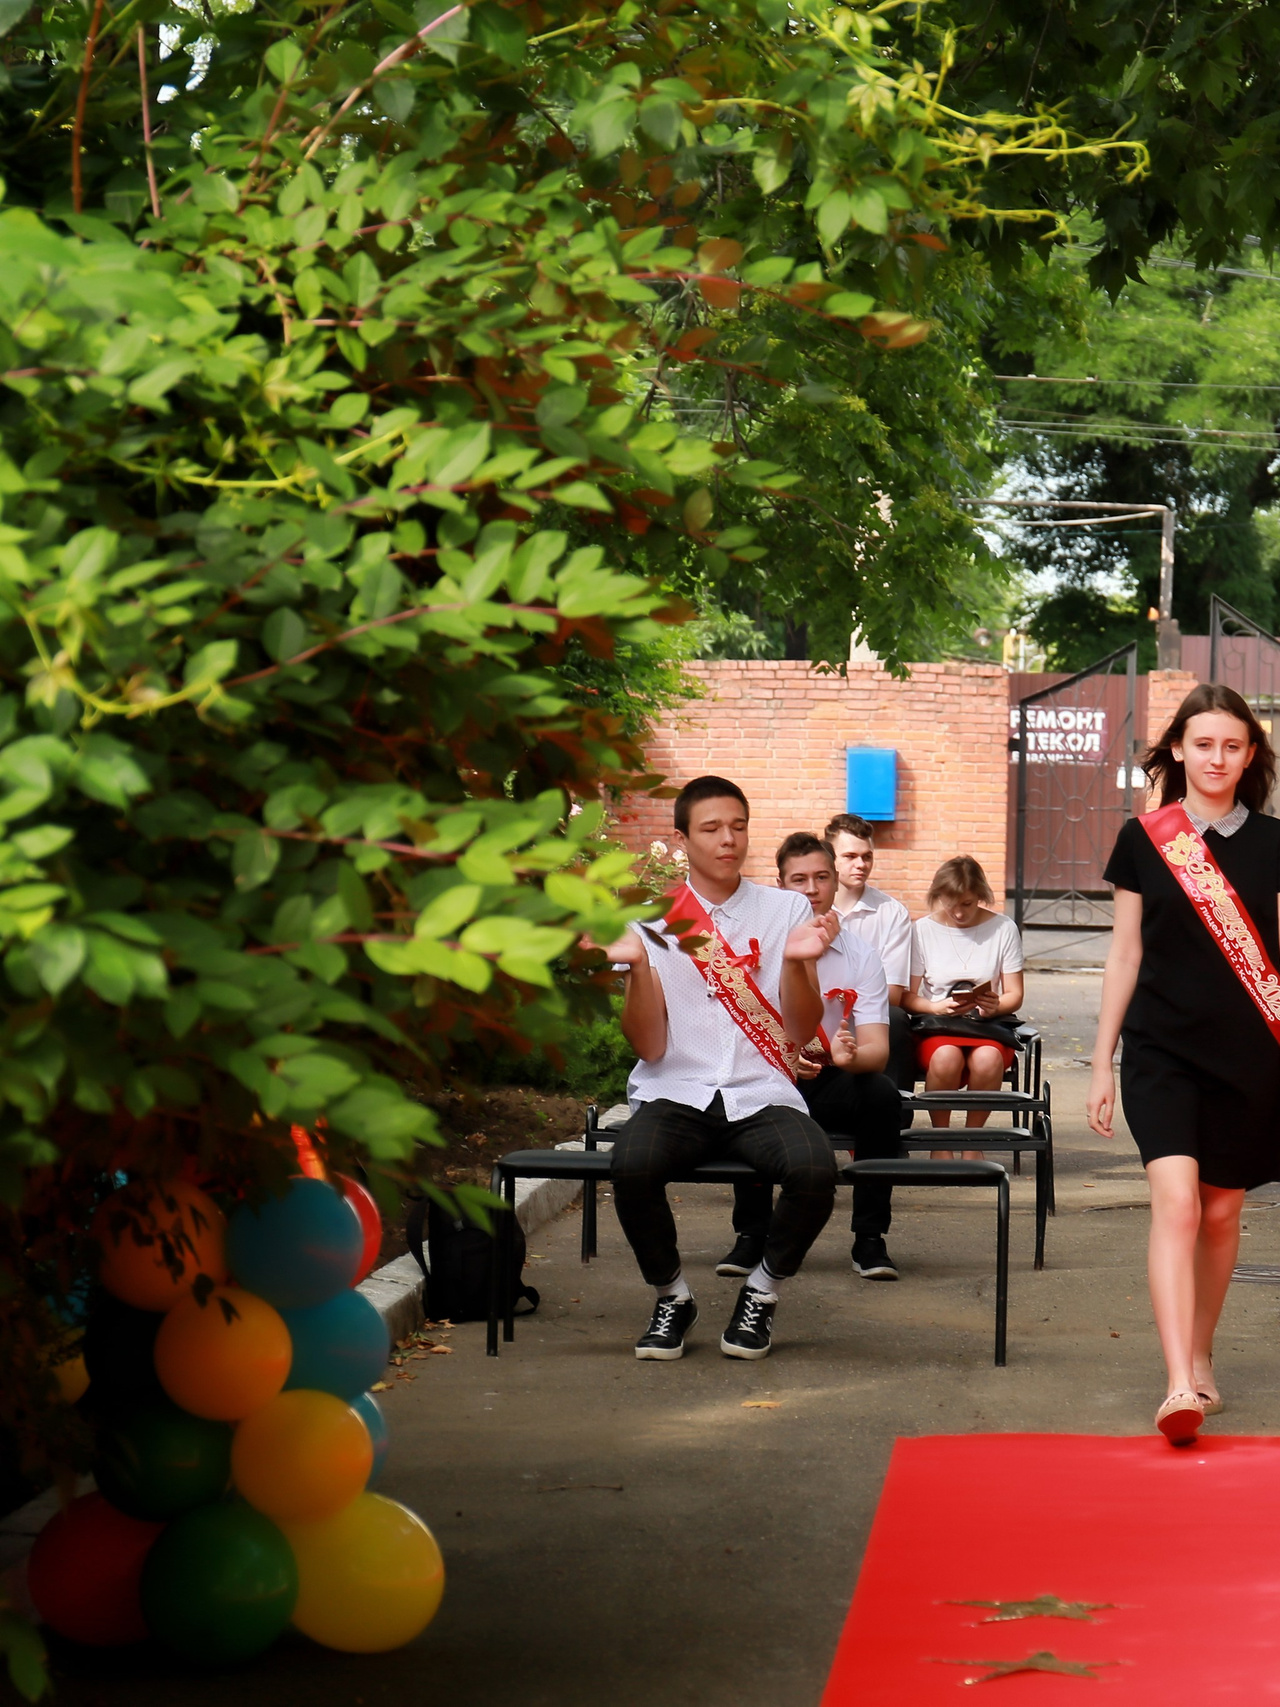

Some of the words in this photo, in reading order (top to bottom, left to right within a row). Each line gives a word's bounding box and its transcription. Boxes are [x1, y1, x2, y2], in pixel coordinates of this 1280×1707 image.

[1009, 709, 1106, 731] РЕМОНТ
[1012, 732, 1100, 752] ТЕКОЛ
[1179, 872, 1205, 904] МБОУ
[1199, 905, 1223, 938] лицей
[1220, 938, 1238, 964] №12
[721, 996, 744, 1023] лицей
[742, 1021, 761, 1043] №12
